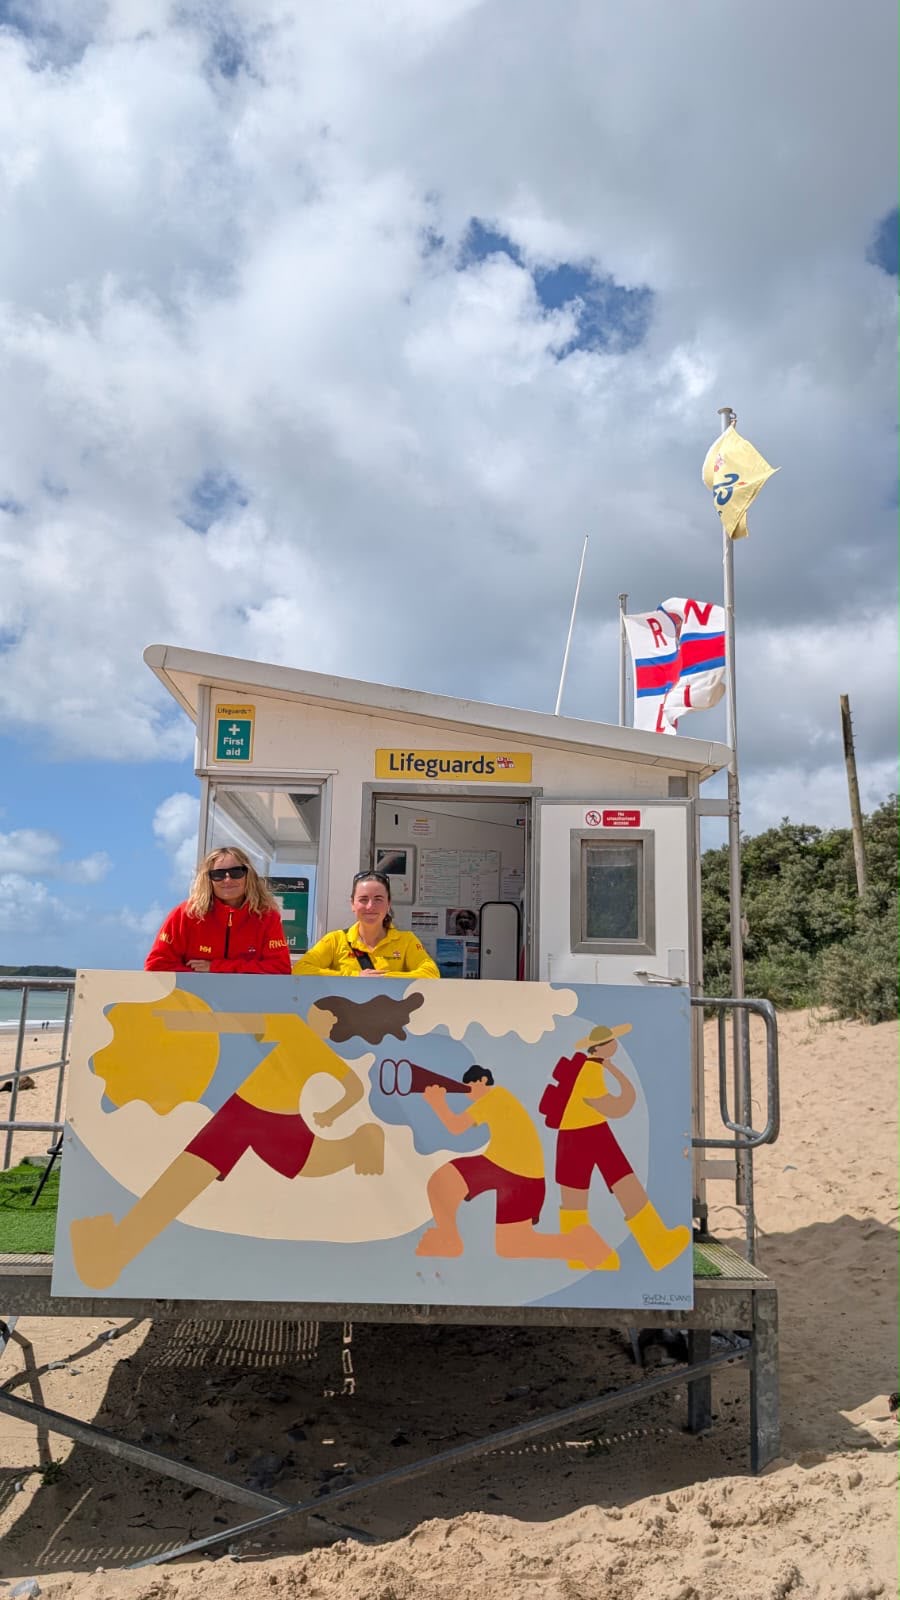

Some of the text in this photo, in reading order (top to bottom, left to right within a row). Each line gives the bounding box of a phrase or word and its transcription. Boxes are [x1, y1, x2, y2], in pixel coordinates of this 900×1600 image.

[223, 737, 244, 746] First
[225, 747, 241, 756] aid
[389, 753, 495, 778] Lifeguards
[287, 936, 296, 946] id
